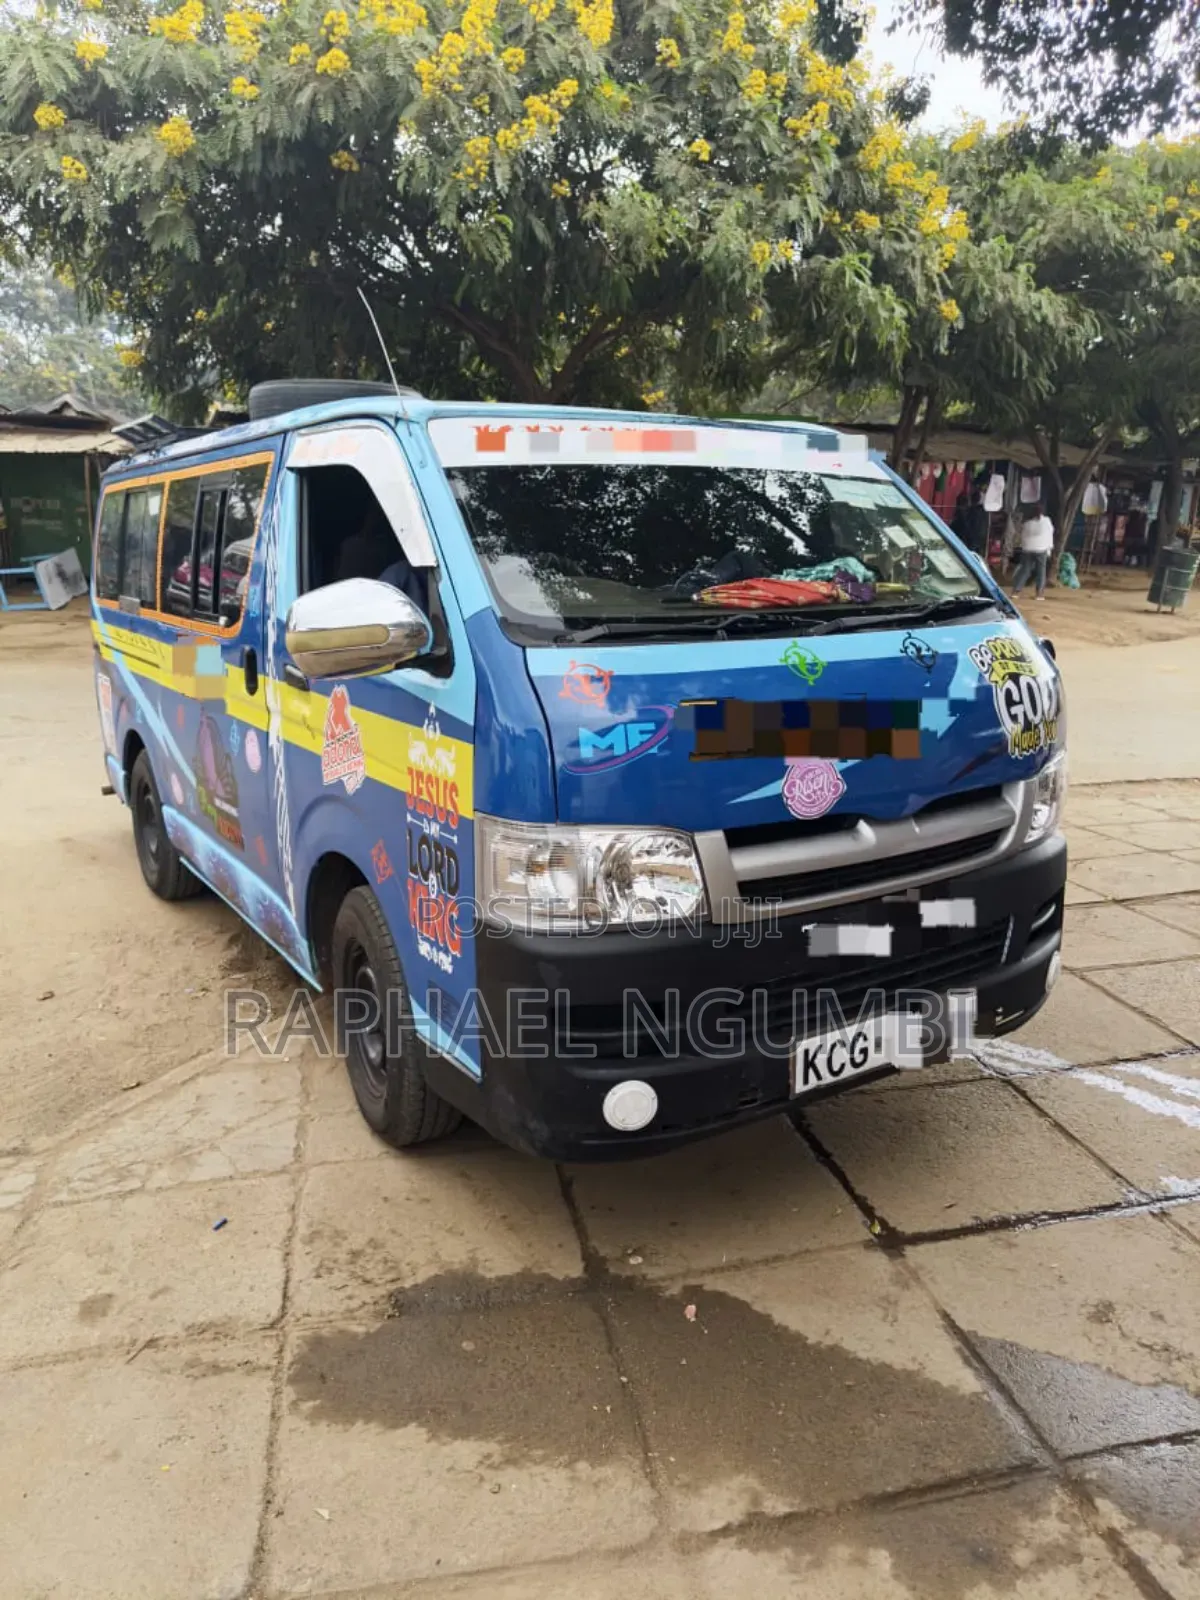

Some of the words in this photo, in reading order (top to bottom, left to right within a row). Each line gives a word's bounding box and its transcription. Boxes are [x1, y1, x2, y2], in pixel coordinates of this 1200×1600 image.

[578, 722, 657, 758] MF
[406, 766, 459, 829] JESUS
[406, 827, 460, 899] LORD
[407, 878, 462, 957] KING
[802, 1031, 868, 1086] KCG
